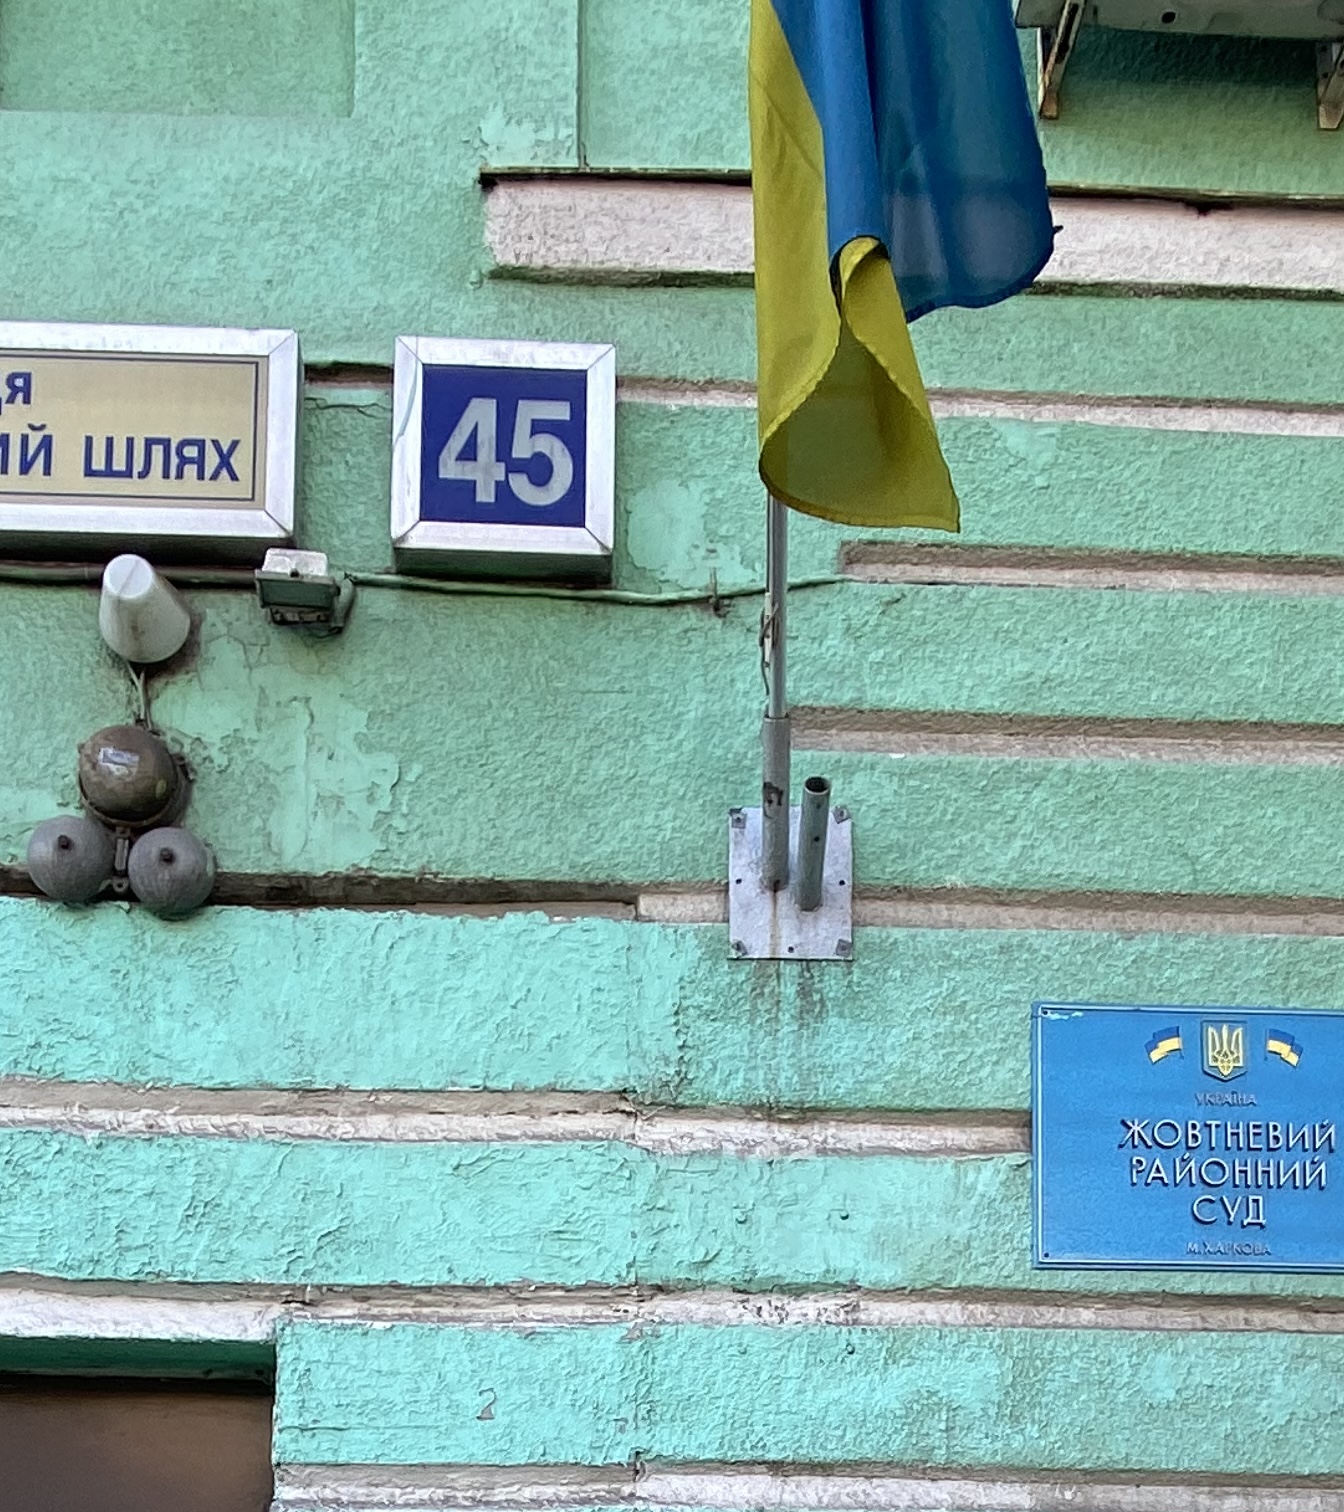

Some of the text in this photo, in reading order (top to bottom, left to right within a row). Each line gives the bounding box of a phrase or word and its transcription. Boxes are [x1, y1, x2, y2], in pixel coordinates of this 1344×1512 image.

[82, 435, 241, 483] ШЛЯХ
[438, 397, 574, 507] 45
[1118, 1118, 1337, 1152] ЖОВТНЕВИЙ
[1129, 1152, 1328, 1190] РАЙОННИЙ
[1191, 1194, 1267, 1229] СУД
